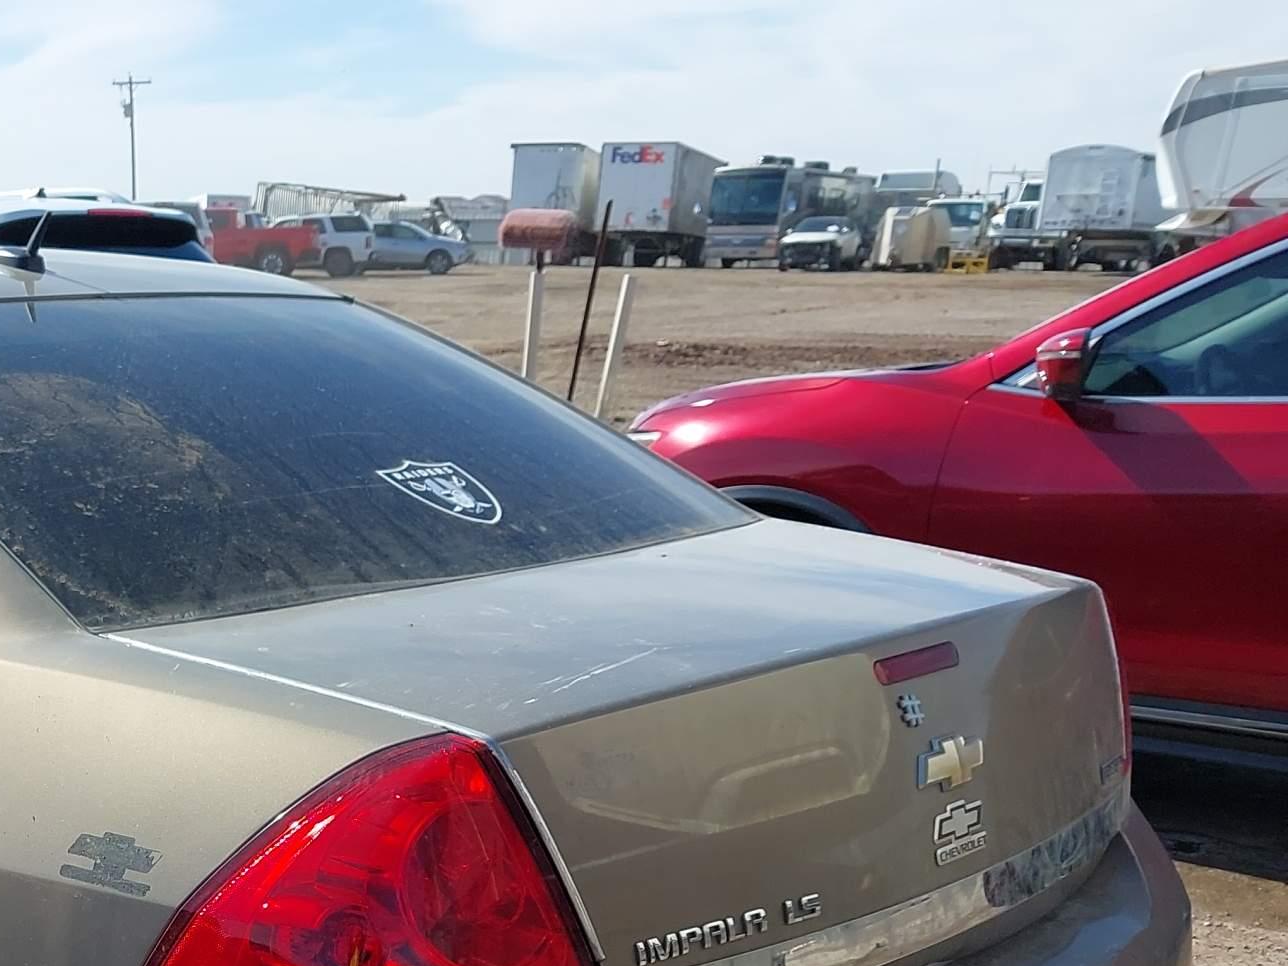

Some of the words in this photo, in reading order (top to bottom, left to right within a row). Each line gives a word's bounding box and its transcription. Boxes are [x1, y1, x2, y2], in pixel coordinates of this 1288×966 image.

[611, 146, 664, 164] FedEx
[392, 466, 454, 481] RAIDERS
[636, 908, 768, 966] IMPALA
[784, 893, 822, 925] LS
